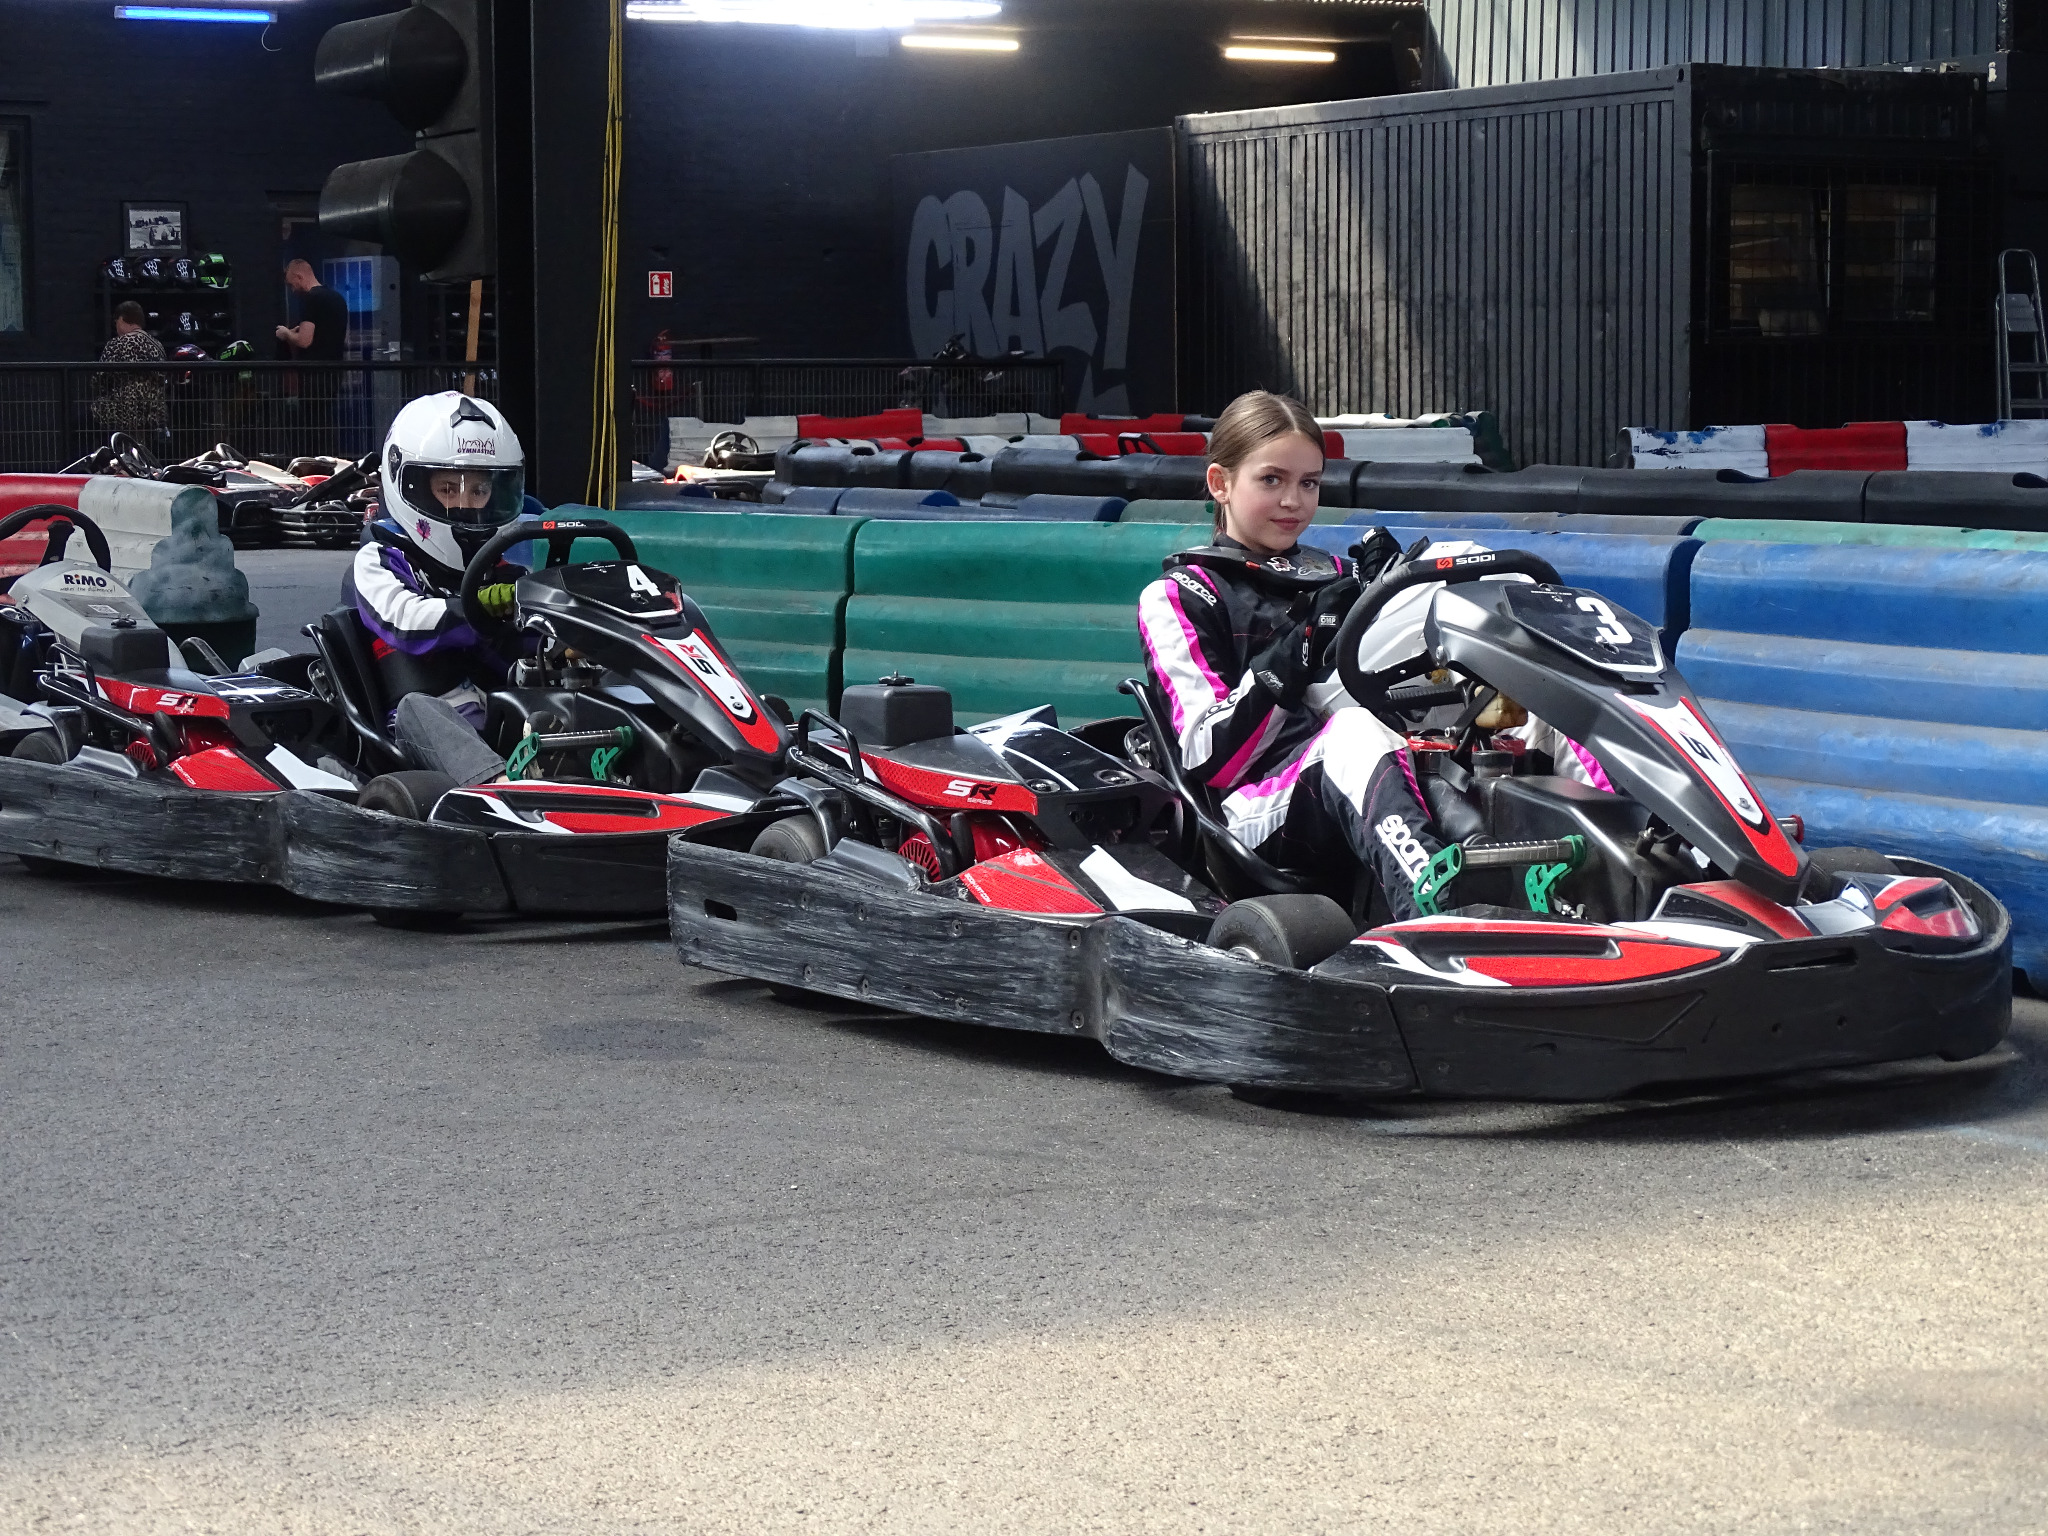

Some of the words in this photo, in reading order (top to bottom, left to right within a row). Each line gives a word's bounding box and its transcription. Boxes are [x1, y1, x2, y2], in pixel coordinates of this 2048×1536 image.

[907, 162, 1149, 370] CRAZY
[1455, 554, 1496, 565] SODI
[627, 564, 661, 597] 4
[1169, 572, 1217, 606] sparco
[1320, 616, 1337, 624] OMP
[1575, 597, 1633, 645] 3
[942, 780, 998, 801] SR
